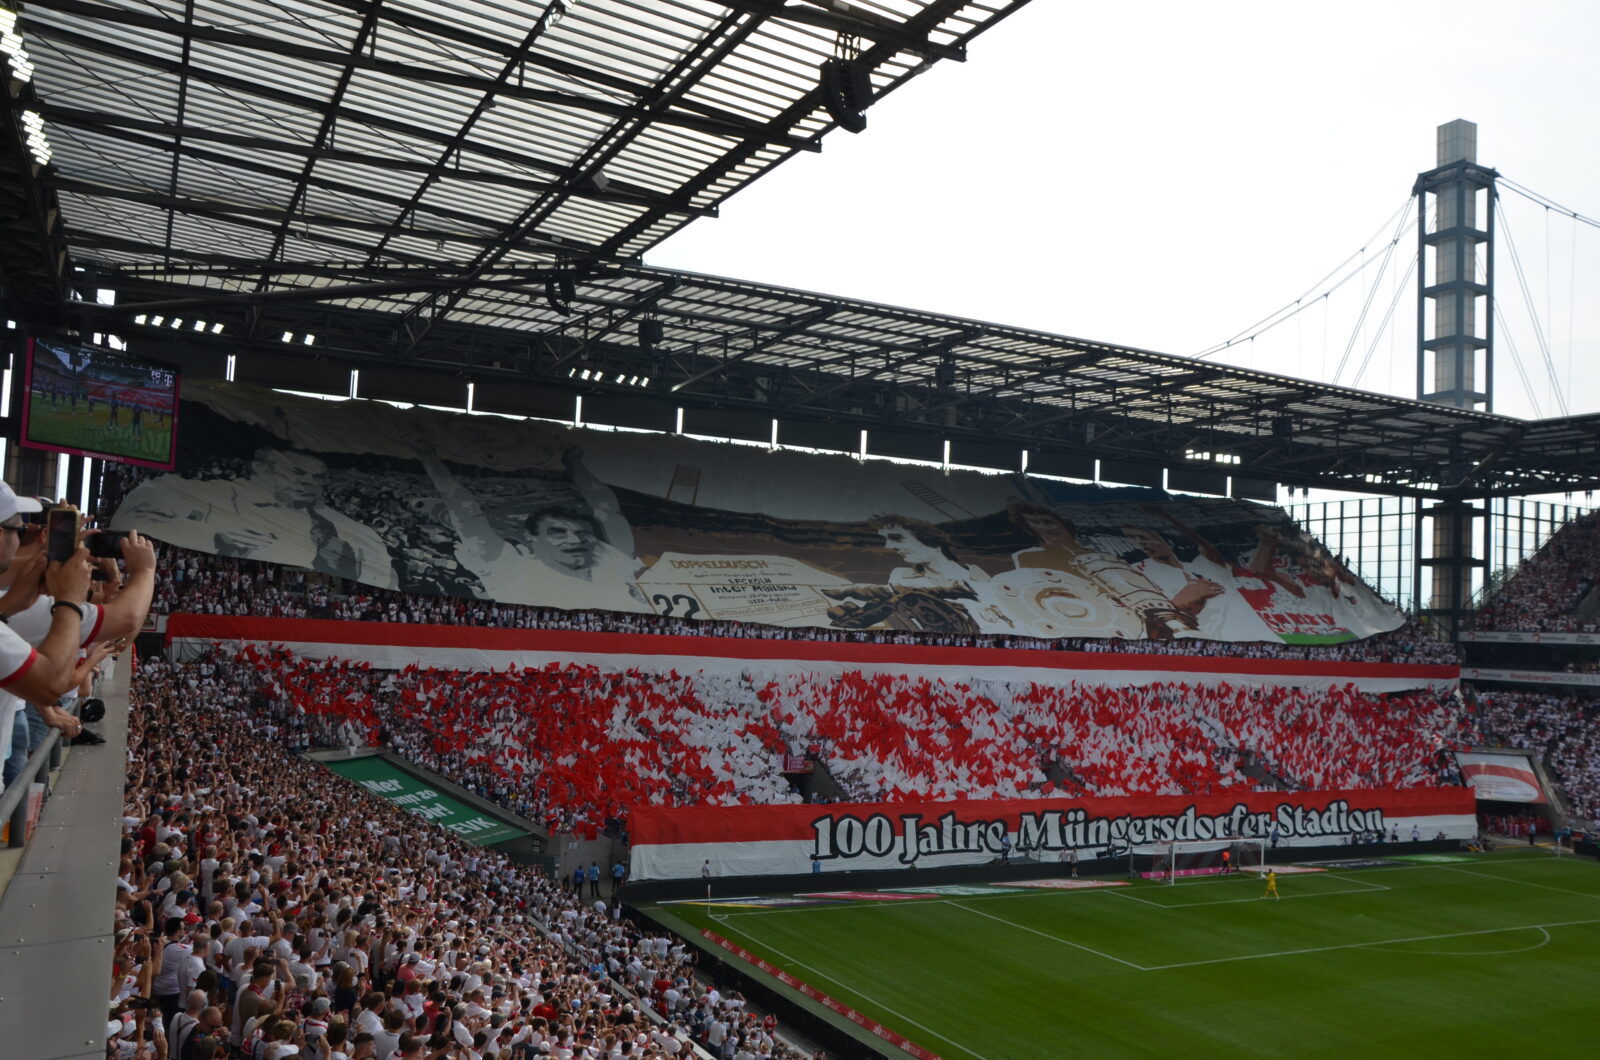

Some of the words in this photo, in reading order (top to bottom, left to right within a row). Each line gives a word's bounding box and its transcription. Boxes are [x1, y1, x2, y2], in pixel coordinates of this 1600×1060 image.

[653, 594, 700, 619] 22
[359, 779, 404, 794] Mer
[447, 817, 499, 834] EVK
[811, 813, 895, 860] 100
[899, 810, 1009, 864] Jahre
[1015, 802, 1271, 859] Müngersdorfer
[1274, 800, 1386, 838] Stadion
